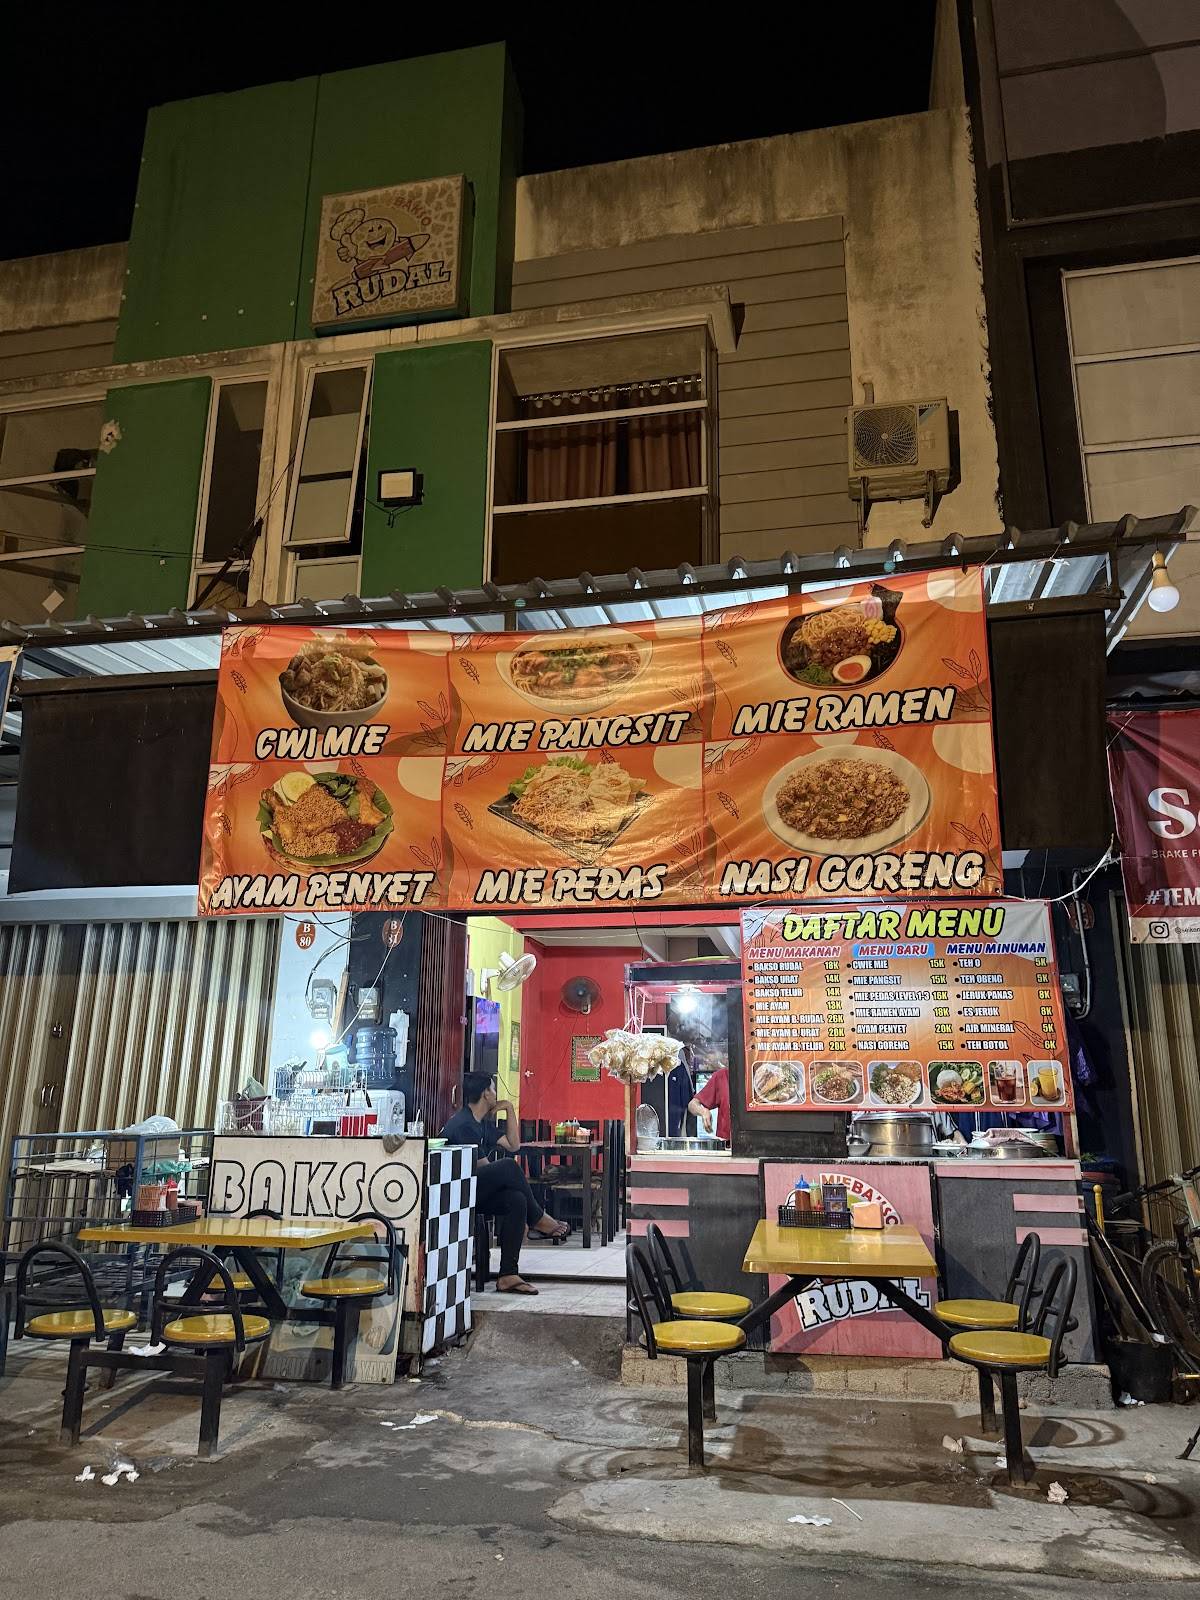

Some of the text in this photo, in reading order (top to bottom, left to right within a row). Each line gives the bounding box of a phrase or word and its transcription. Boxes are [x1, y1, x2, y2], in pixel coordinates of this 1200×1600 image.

[332, 261, 451, 316] RUDAL
[732, 686, 957, 736] MIE RAMEN
[462, 710, 692, 752] MIE PANGSIT
[255, 724, 390, 760] CWI MIE
[1151, 849, 1188, 859] BRAKE
[719, 851, 985, 896] NASI GORENG
[474, 863, 668, 904] MIE PEDAS
[210, 871, 435, 909] AYAM PENYET
[303, 922, 311, 933] B
[390, 920, 398, 930] B
[782, 907, 1005, 941] DAFTAR MENU
[299, 937, 311, 947] 80
[749, 946, 841, 959] MENU MAKANAN
[859, 944, 928, 956] MENU BARU
[947, 942, 1046, 954] MENU MINUMAN
[754, 962, 779, 971] BAKSO
[780, 962, 802, 971] RUDAL
[852, 959, 945, 969] CWIE MIE 15K
[959, 959, 974, 968] TEH
[1035, 957, 1047, 966] 5K
[754, 974, 840, 984] BAKSO URAT 14K
[853, 975, 946, 985] MIE PANGSIT 15K
[960, 974, 976, 984] TEH
[976, 974, 1003, 983] OBENG
[754, 987, 840, 997] BAKSO TELUR 14K
[854, 992, 870, 1001] MIE
[870, 991, 894, 1001] PEDAS
[896, 991, 917, 1001] LEVEL
[917, 991, 930, 1000] 1-3
[962, 990, 1050, 1000] JERUK PANAS 8K
[756, 1002, 770, 1011] MIE
[770, 1001, 790, 1010] AYAM
[963, 1006, 1052, 1016] ES JERUK 8K
[856, 1007, 950, 1017] MIE RAMEN AYAM 18K
[756, 1015, 770, 1024] MIE
[771, 1015, 790, 1024] AYAM
[800, 1014, 824, 1024] RUDAL
[756, 1028, 770, 1037] MIE
[771, 1028, 791, 1037] AYAM
[800, 1028, 820, 1037] URAT
[856, 1024, 952, 1034] AYAM PENYET 20K
[965, 1023, 1055, 1033] AIR MINERAL 5K
[757, 1042, 770, 1051] MIE
[772, 1042, 792, 1051] AYAM
[802, 1042, 824, 1051] TELUR
[858, 1040, 954, 1050] NASI GORENG 15K
[966, 1040, 1056, 1050] TEH BOTOL 6K
[208, 1160, 420, 1220] BAKSO
[852, 1180, 898, 1224] BASO
